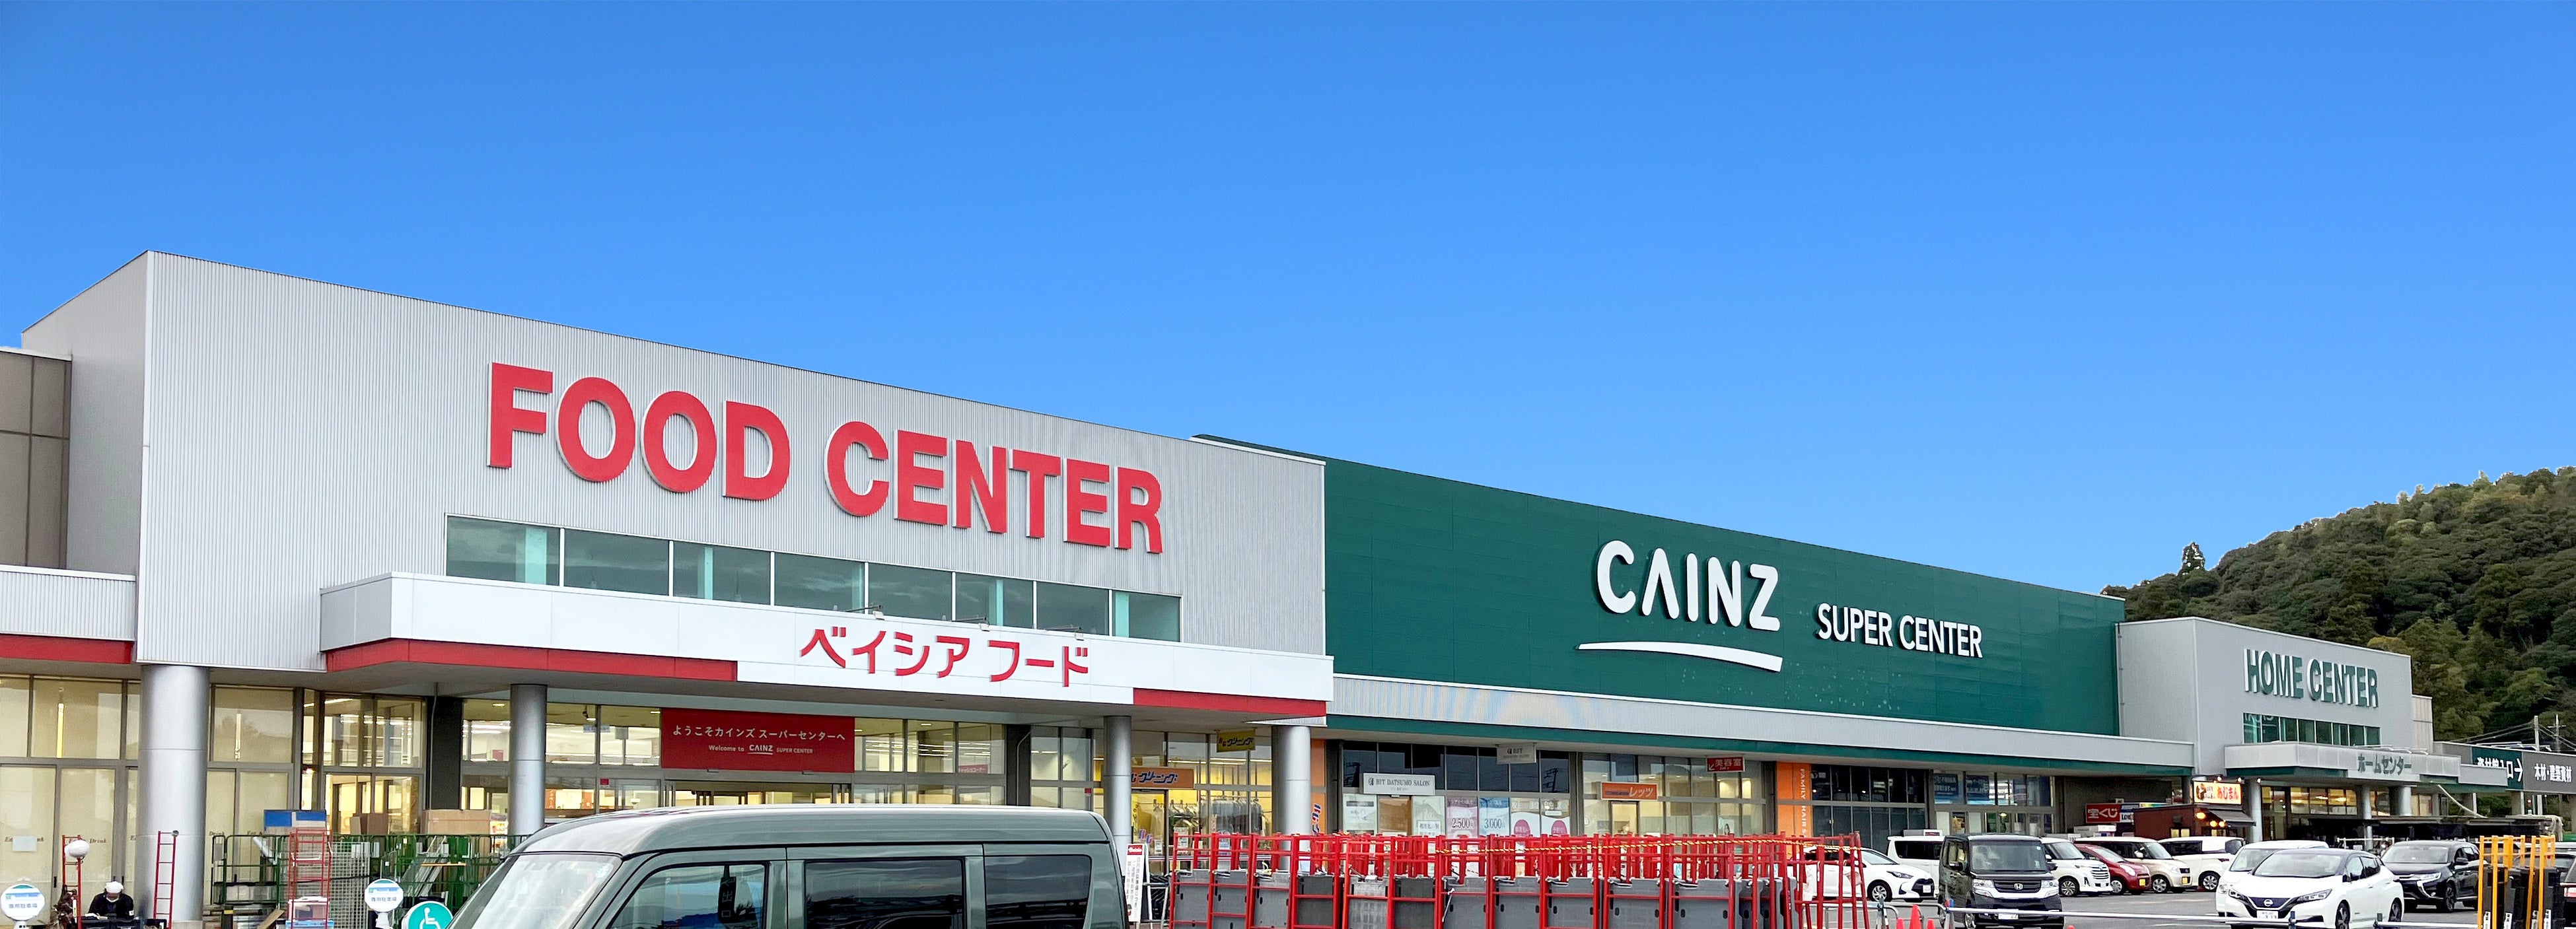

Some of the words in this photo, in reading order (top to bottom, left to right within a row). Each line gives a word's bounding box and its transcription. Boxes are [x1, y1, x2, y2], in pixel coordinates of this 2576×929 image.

[488, 362, 791, 501] FOOD
[824, 421, 1163, 555] CENTER
[1595, 539, 1781, 632] CAINZ
[800, 626, 970, 679] ベイシア
[989, 638, 1089, 688] フード
[1816, 603, 1893, 647] SUPER
[1898, 614, 1983, 658] CENTER
[2243, 648, 2304, 699] HOME
[2306, 658, 2379, 708] CENTER
[672, 725, 756, 738] ようこそカインズ
[759, 729, 845, 741] スーパーセンターへ
[2357, 753, 2412, 775] ホームセンター
[1629, 786, 1654, 798] レッツ
[2087, 808, 2118, 819] 宝くじ
